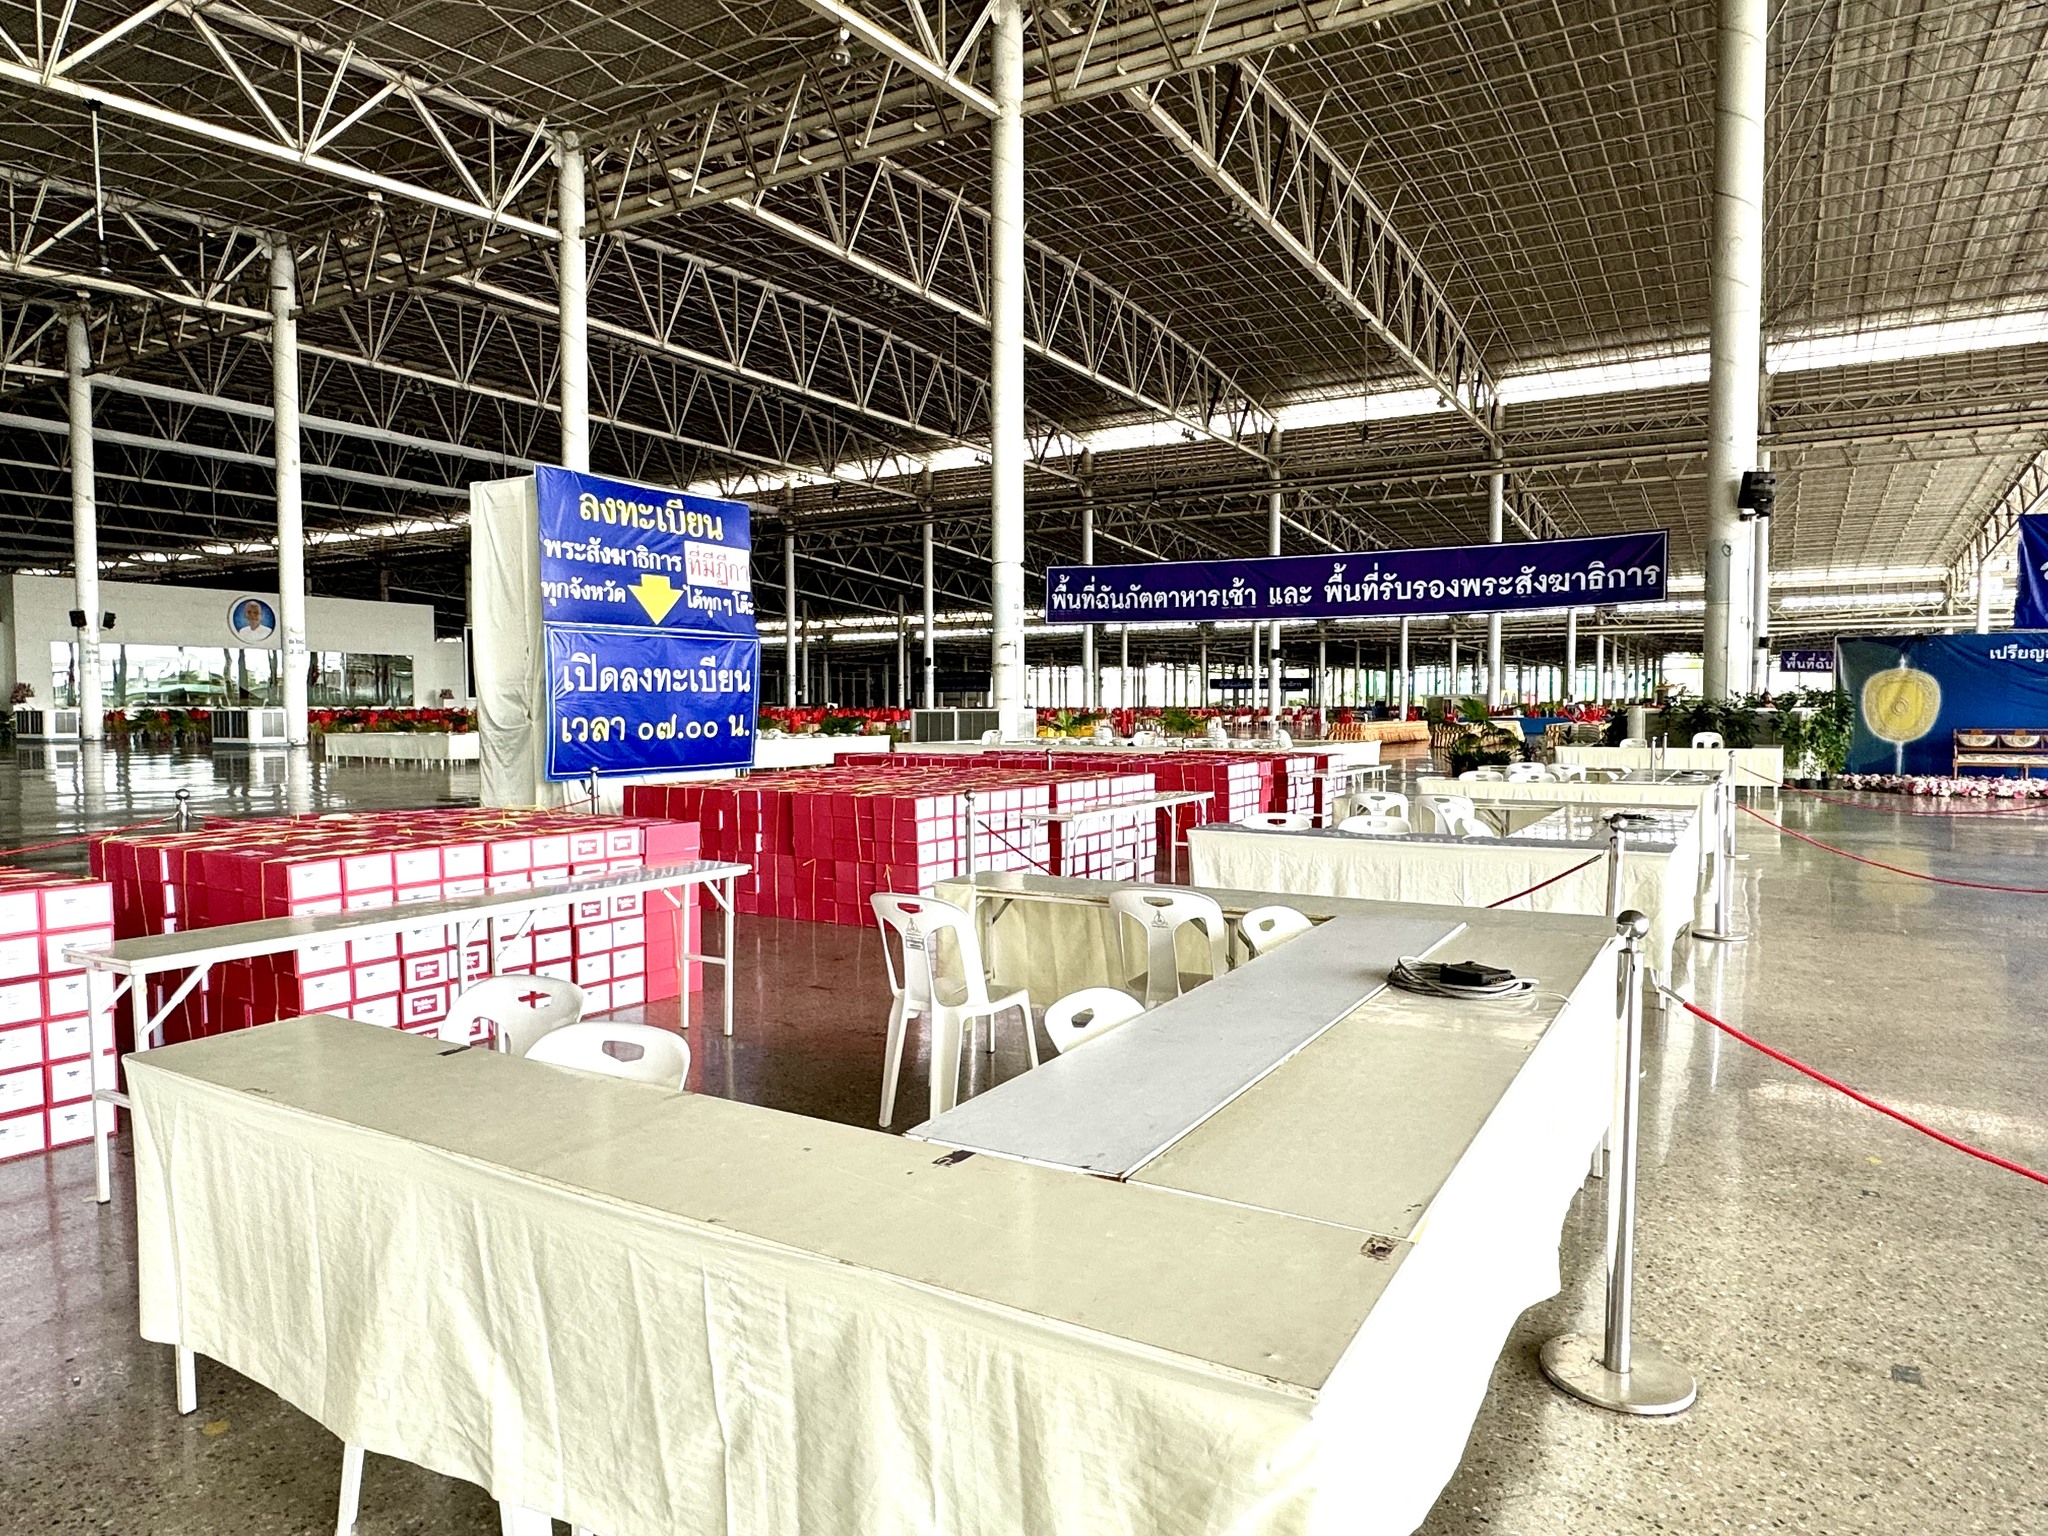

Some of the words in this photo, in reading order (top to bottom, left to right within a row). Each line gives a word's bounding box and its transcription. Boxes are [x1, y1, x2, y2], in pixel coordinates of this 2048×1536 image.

[579, 493, 724, 541] ลงทะเบียน
[543, 536, 682, 573] พระสังฆาธิการ
[541, 577, 626, 607] ทุกจังหวัด
[1051, 574, 1257, 610] พื้นที่ฉันภัตตาหารเช้า
[1269, 585, 1312, 605] และ
[1323, 560, 1661, 603] พื้นที่รับรองพระสังฆาธิการ
[1989, 643, 2048, 662] เปรียญ
[562, 651, 751, 693] เปิดลงทะเบียน
[561, 715, 626, 742] เวลา
[638, 713, 719, 740] ๐๗.๐๐
[728, 714, 750, 737] น.
